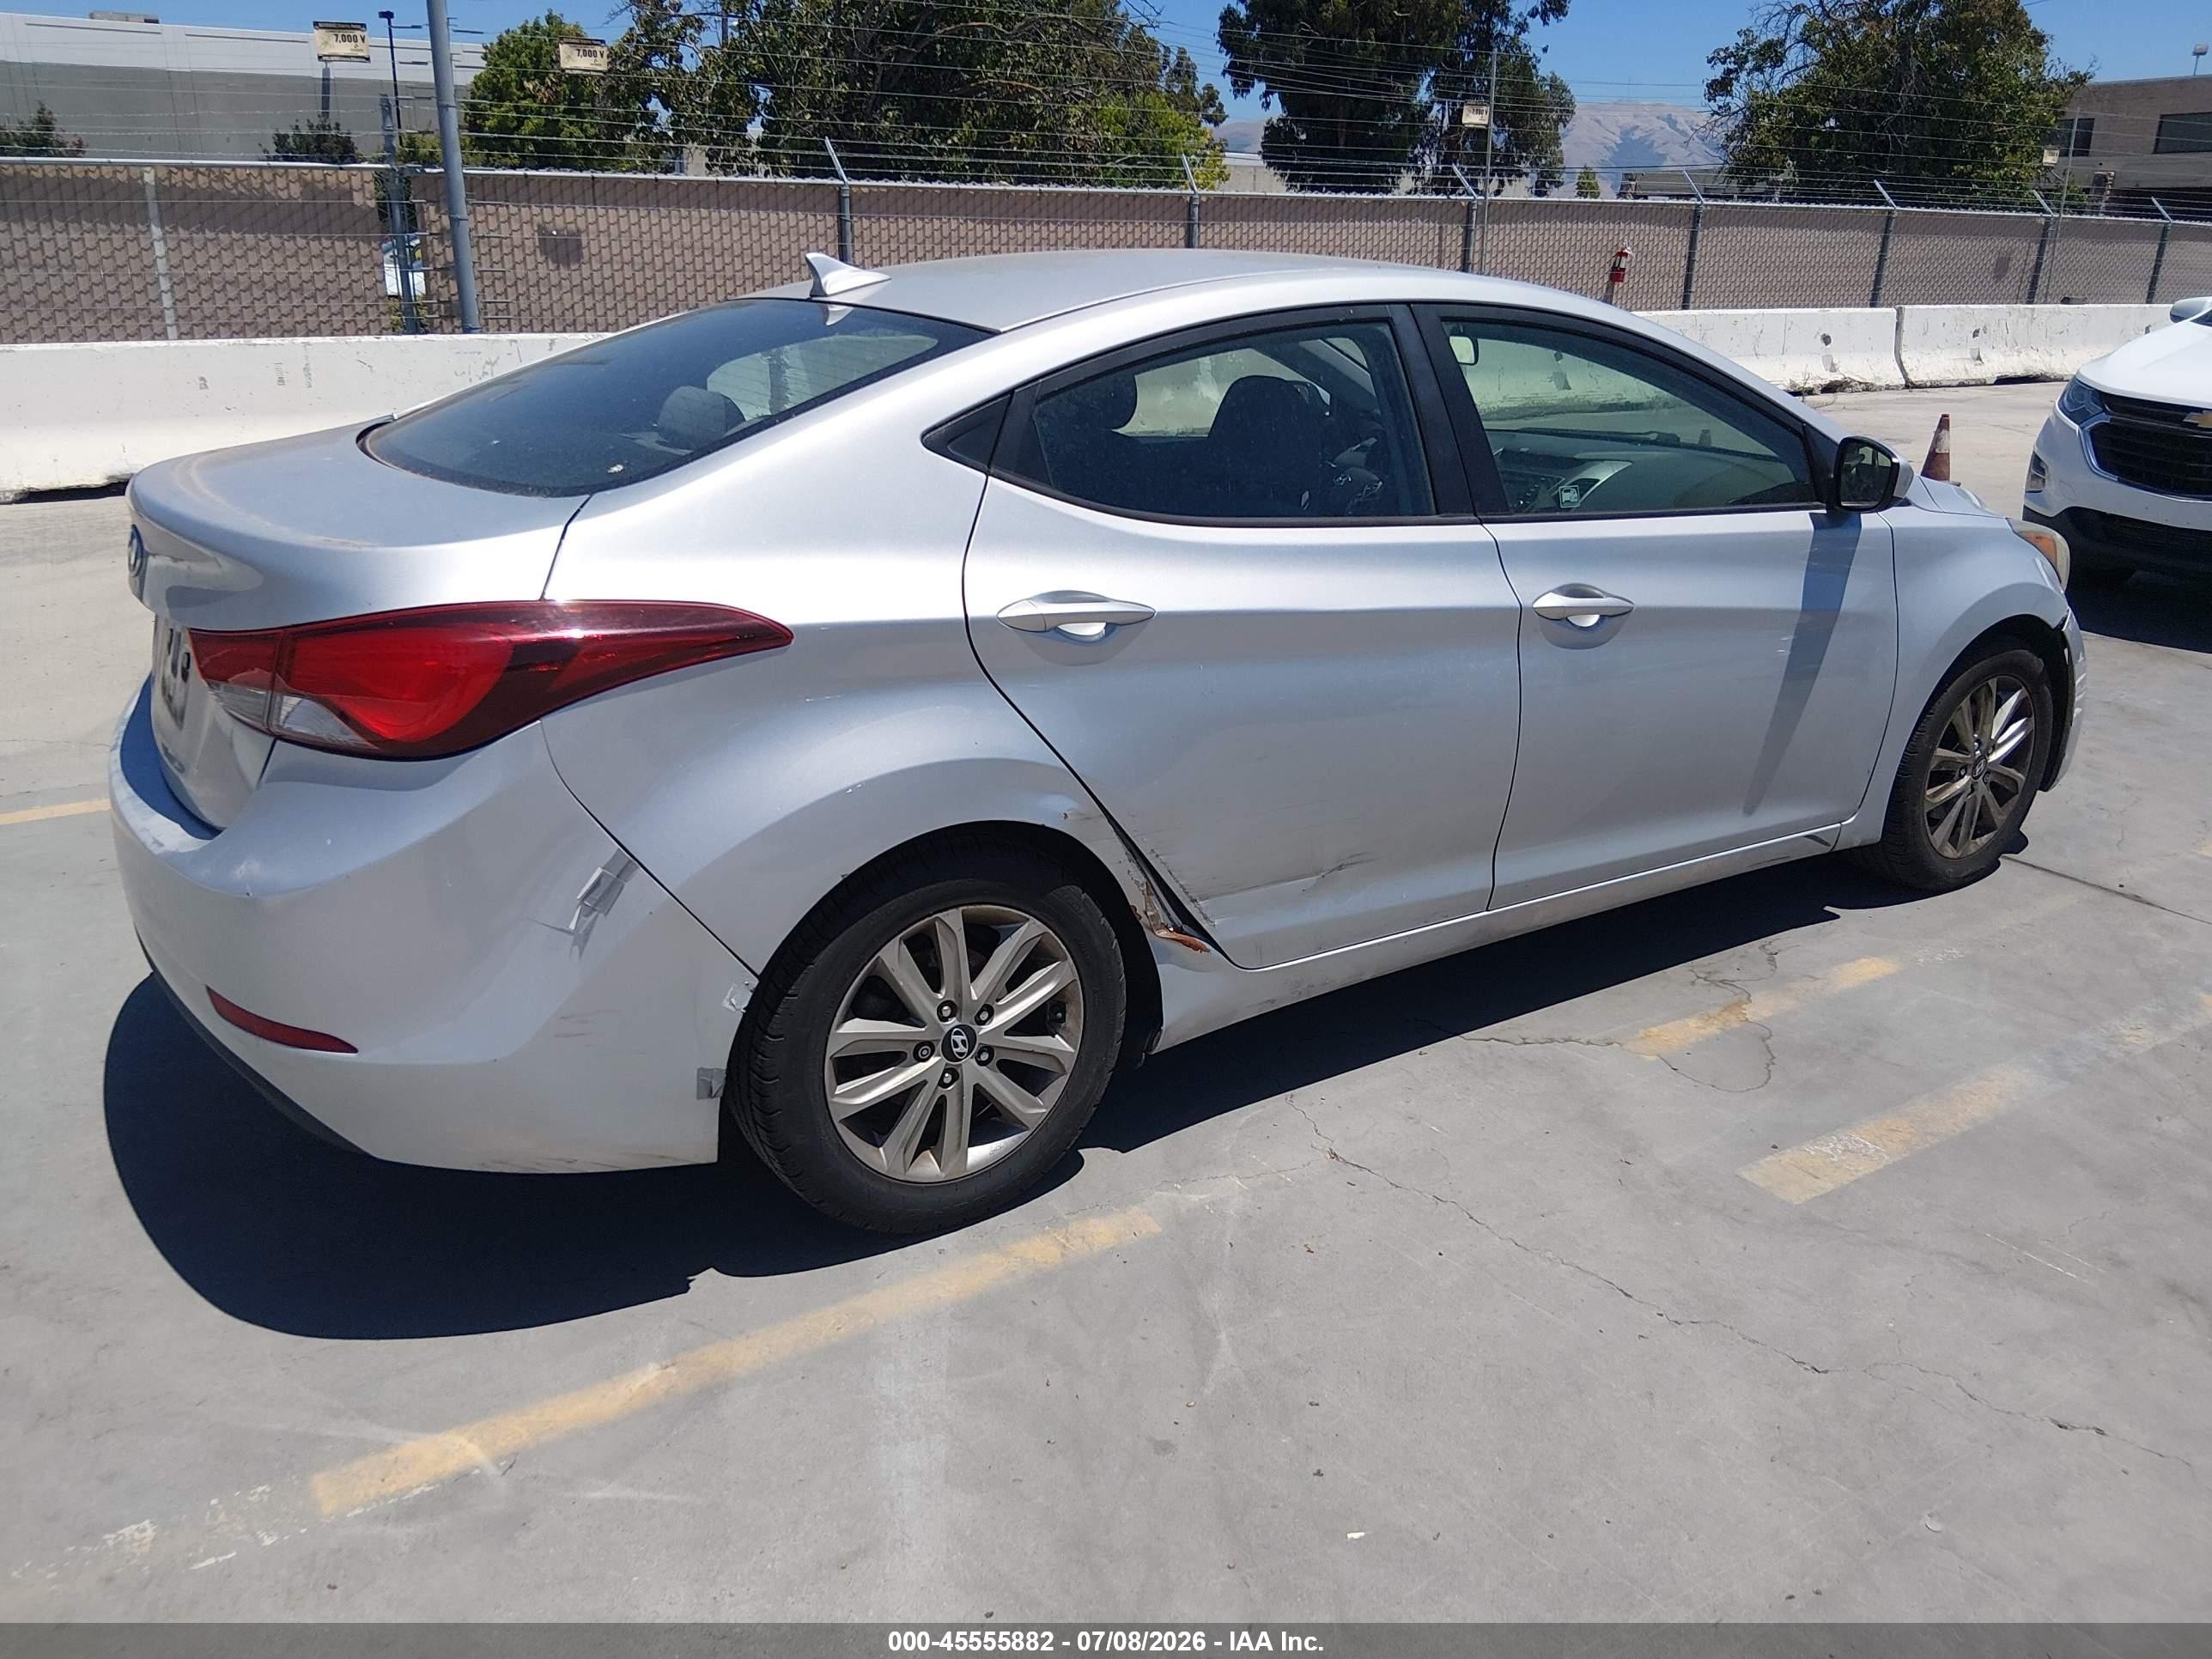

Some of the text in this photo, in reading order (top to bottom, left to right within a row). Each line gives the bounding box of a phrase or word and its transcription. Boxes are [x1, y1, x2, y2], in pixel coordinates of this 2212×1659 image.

[333, 33, 366, 44] 7,000 V
[576, 48, 605, 58] 7,000 V
